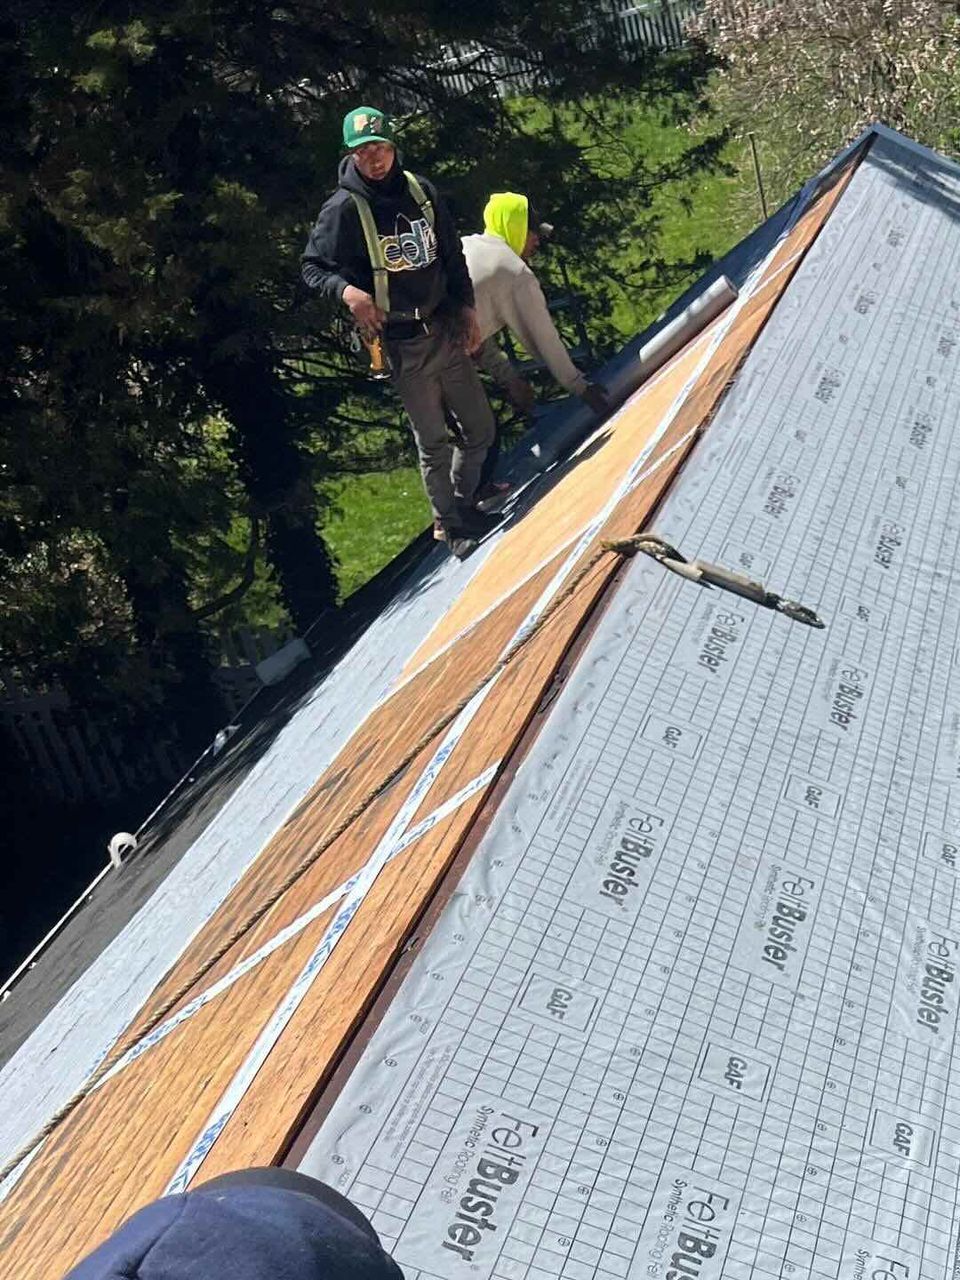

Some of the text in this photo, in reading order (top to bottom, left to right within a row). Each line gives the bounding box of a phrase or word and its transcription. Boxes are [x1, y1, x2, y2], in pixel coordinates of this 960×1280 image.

[828, 664, 868, 731] FeltBuster
[662, 726, 682, 749] GAF
[804, 784, 822, 809] GAF
[600, 806, 664, 906] FeltBuster
[940, 843, 958, 867] GAF
[761, 870, 815, 972] FeltBuster
[546, 987, 573, 1020] GAF
[916, 930, 960, 1034] FeltBuster
[723, 1055, 748, 1090] GAF
[464, 1105, 495, 1149] Synthetic
[893, 1122, 913, 1157] GAF
[441, 1113, 539, 1262] FeltBuster
[664, 1178, 688, 1223] Synthetic
